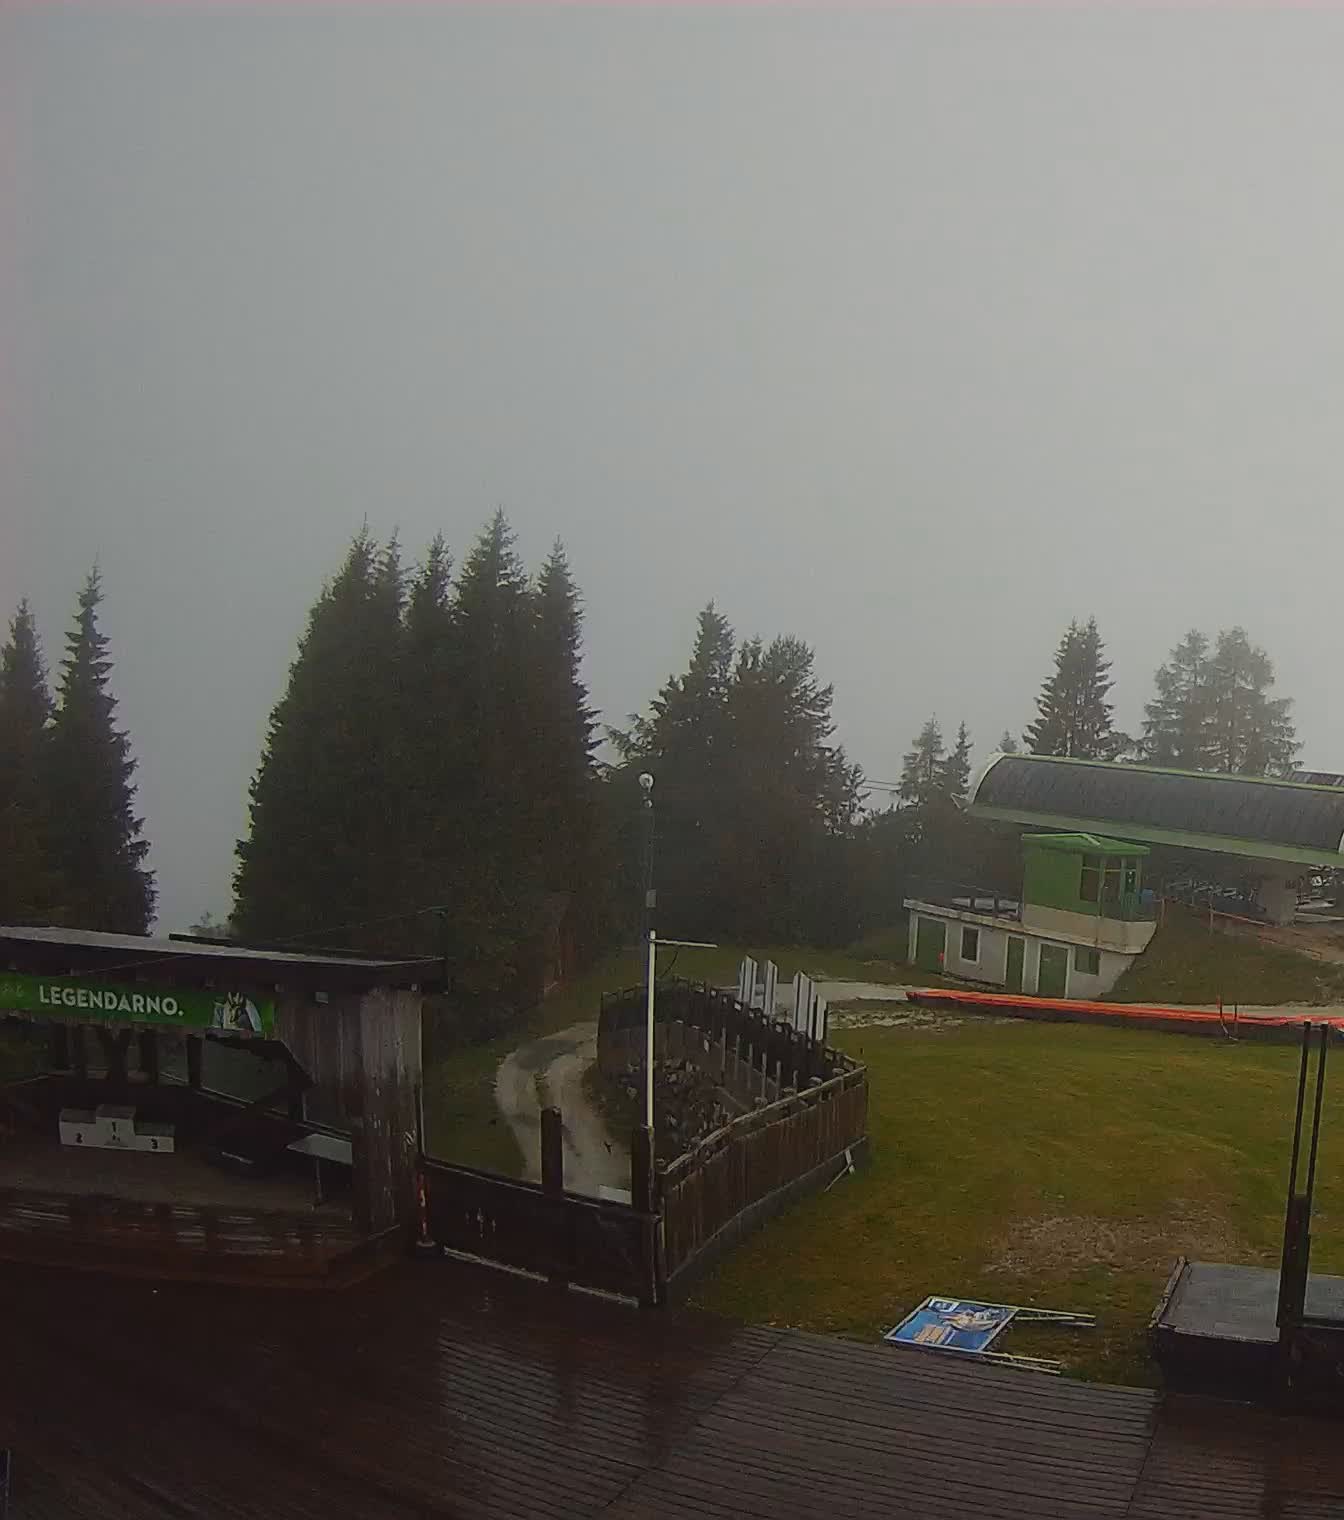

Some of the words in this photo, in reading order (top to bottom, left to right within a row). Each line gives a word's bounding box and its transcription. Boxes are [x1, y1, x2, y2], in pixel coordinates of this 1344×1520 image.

[39, 984, 184, 1016] LEGENDARNO.
[76, 1132, 83, 1144] 2
[151, 1138, 158, 1149] 3
